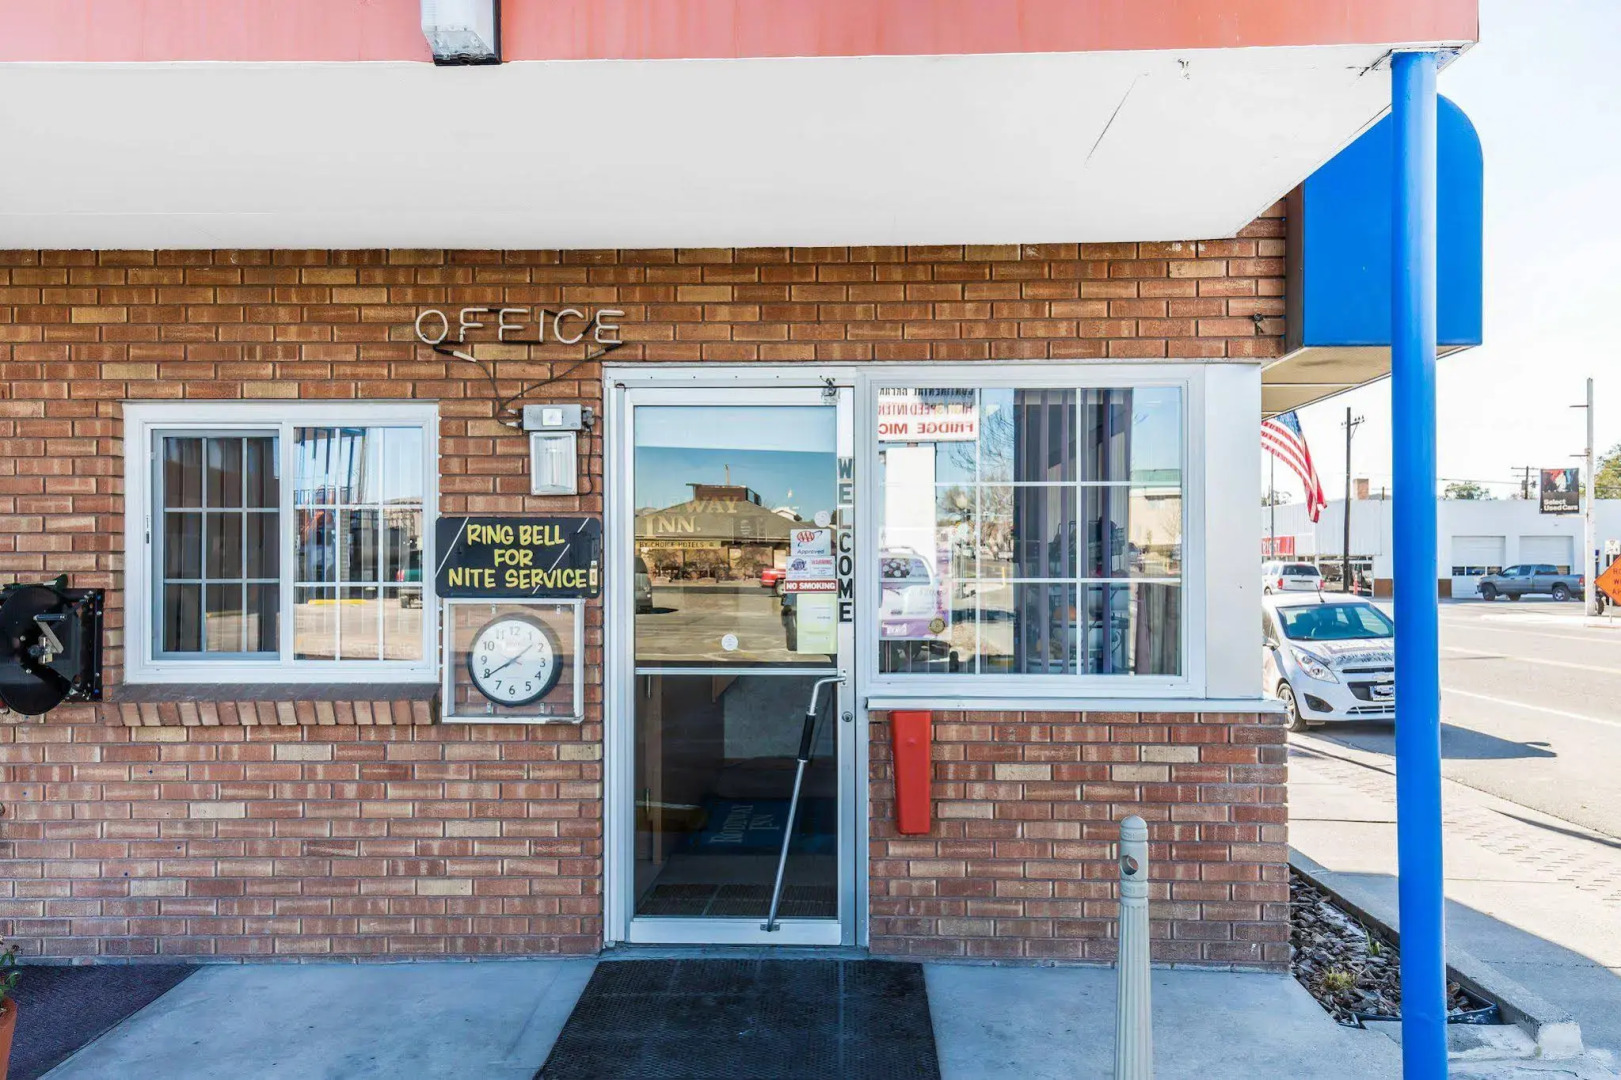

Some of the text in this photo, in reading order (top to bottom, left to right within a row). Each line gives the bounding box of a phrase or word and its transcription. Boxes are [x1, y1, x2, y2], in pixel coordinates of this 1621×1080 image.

[415, 308, 625, 345] OFFICE
[466, 523, 566, 546] RING BELL
[838, 458, 853, 623] WELCOME
[493, 549, 534, 567] FOR
[448, 567, 587, 589] NITE SERVICE
[786, 582, 836, 590] NO SMOKING
[509, 627, 520, 636] 12
[483, 641, 495, 651] 10
[538, 643, 544, 652] 2
[481, 655, 488, 665] 9
[540, 658, 546, 667] 3
[484, 669, 491, 678] 8
[535, 671, 541, 681] 4
[495, 680, 502, 690] 7
[509, 685, 515, 695] 6
[525, 681, 532, 691] 5
